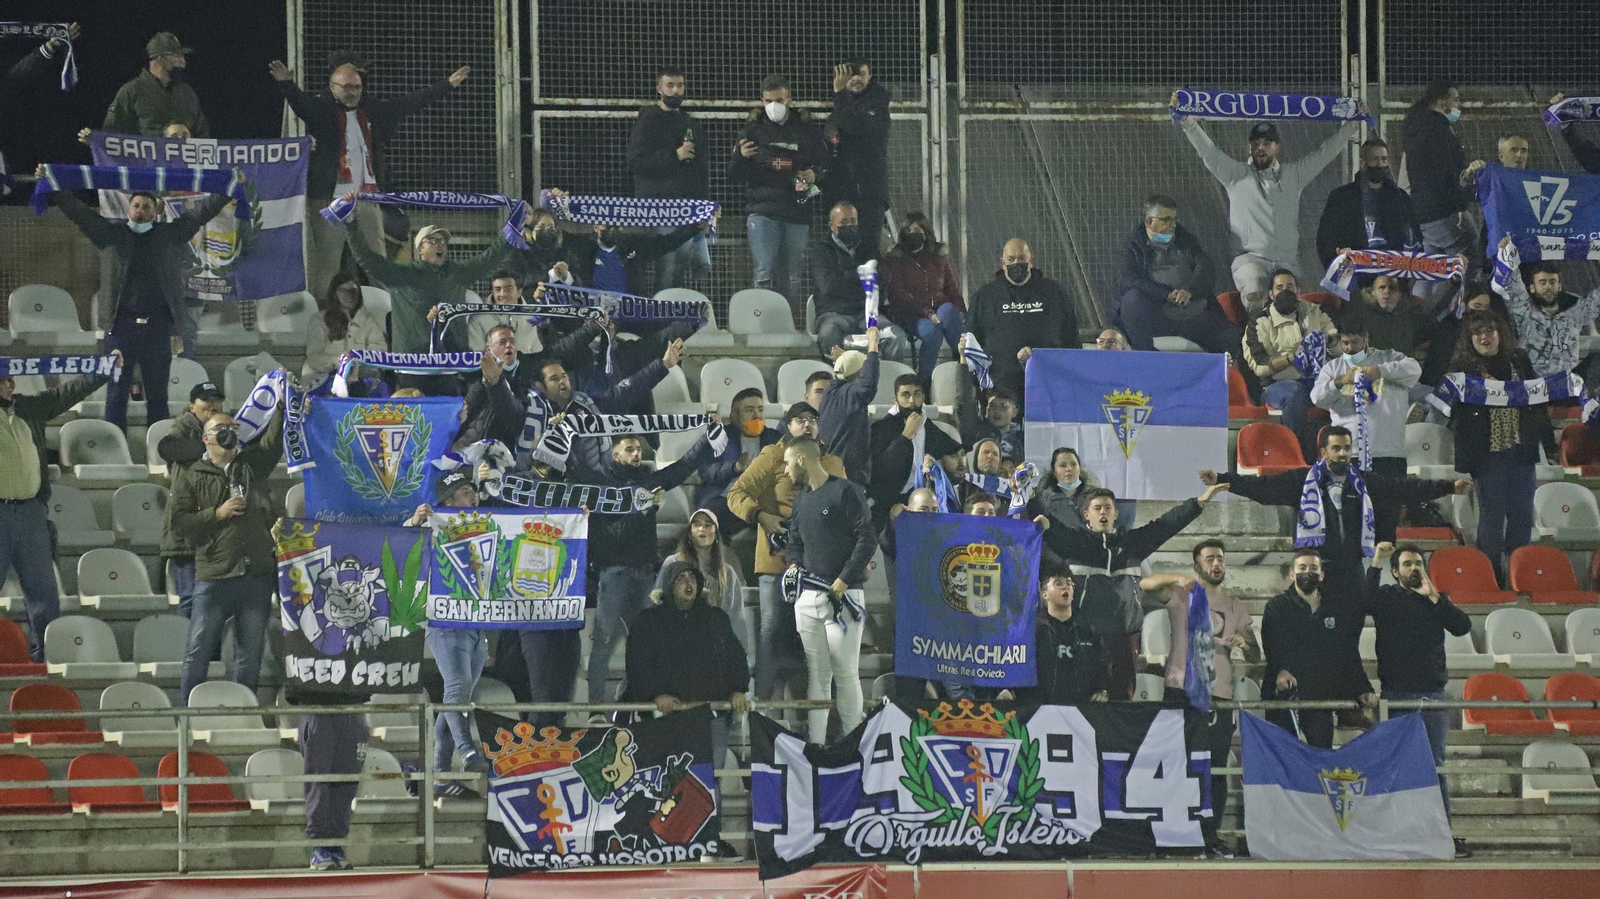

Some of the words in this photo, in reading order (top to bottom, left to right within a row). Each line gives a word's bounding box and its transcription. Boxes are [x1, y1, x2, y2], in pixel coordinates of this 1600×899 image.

[105, 137, 157, 160] SAN
[166, 142, 300, 164] FERNANDO
[580, 205, 609, 216] SAN
[613, 206, 691, 218] FERNANDO
[695, 205, 714, 215] CD
[8, 358, 41, 375] DE
[351, 349, 383, 363] SAN
[385, 351, 460, 365] FERNANDO
[434, 597, 475, 621] SAN
[478, 598, 582, 622] FERNANDO
[285, 654, 347, 686] WEED
[352, 659, 421, 686] CREW
[937, 663, 959, 675] Ultras
[960, 667, 976, 677] Real
[976, 668, 1006, 678] Oviedo
[844, 804, 984, 865] Orgullo
[982, 804, 1084, 855] Isleño
[488, 845, 545, 868] VENCE
[599, 840, 718, 866] NOSOTROS
